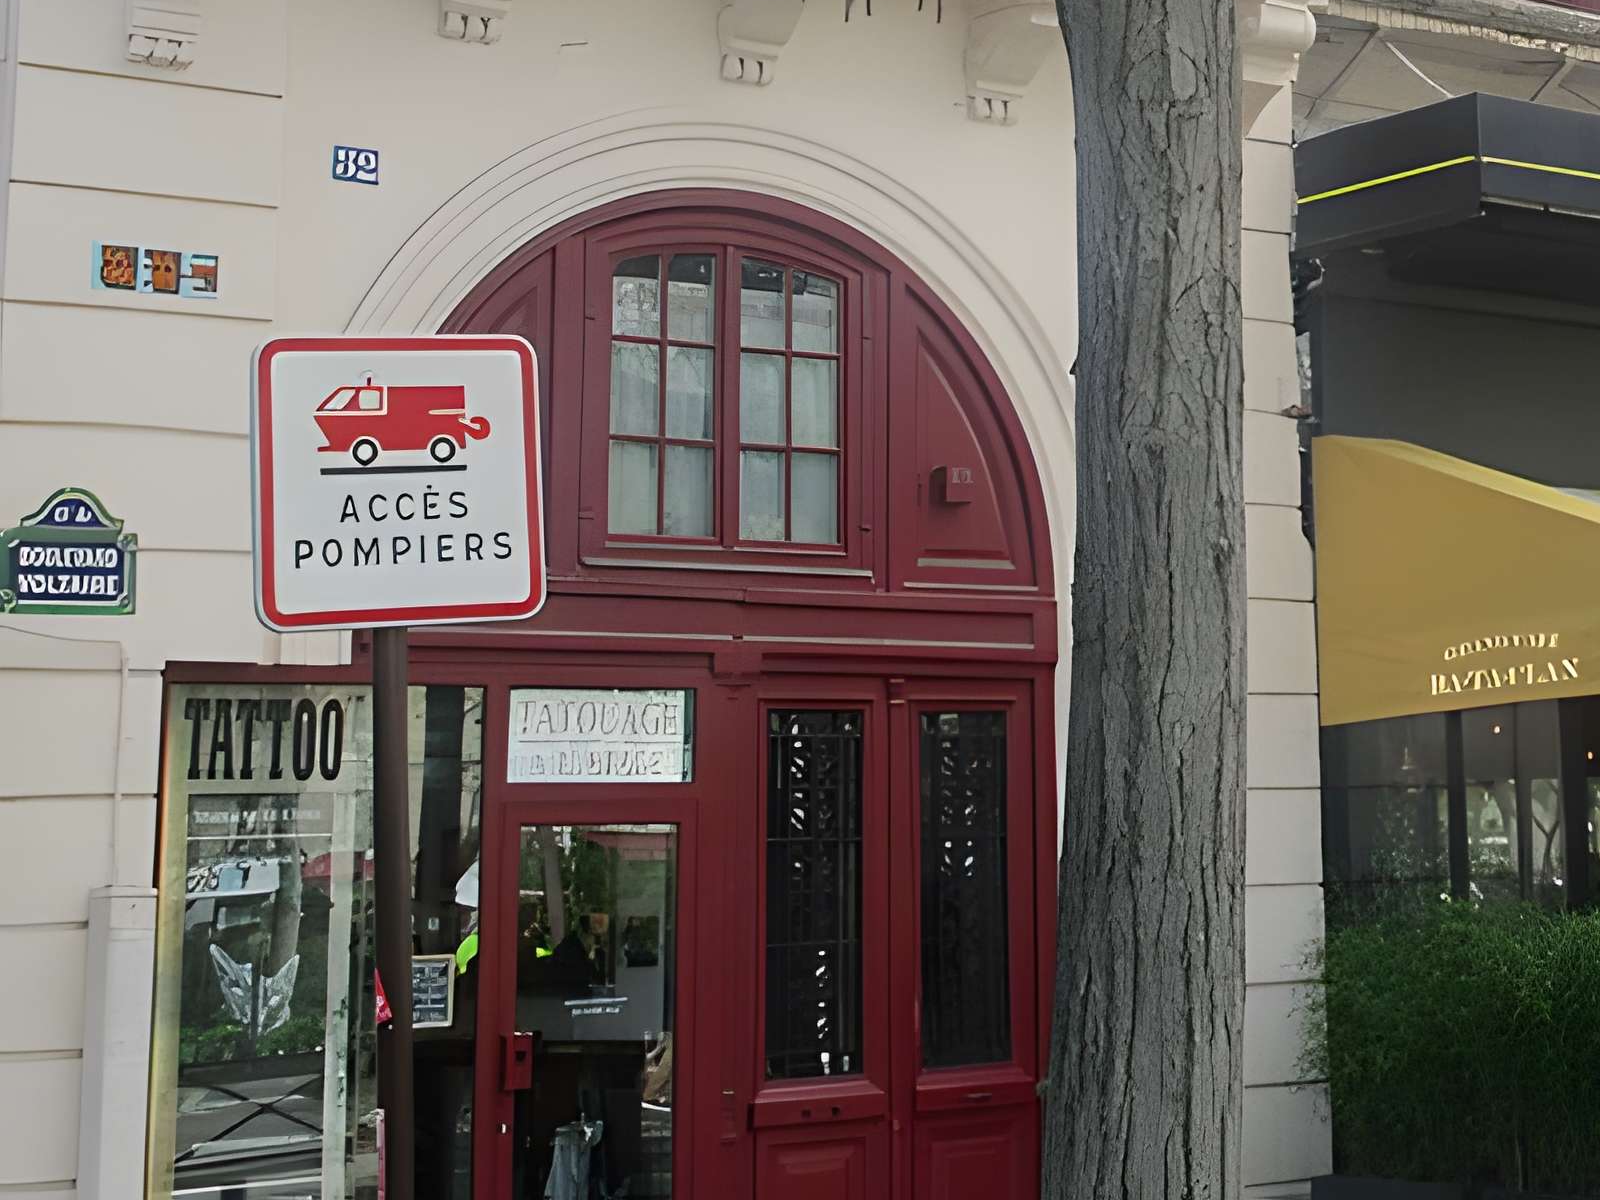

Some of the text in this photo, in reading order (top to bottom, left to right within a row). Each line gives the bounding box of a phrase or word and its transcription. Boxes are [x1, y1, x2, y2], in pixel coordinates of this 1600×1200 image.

[338, 484, 469, 524] ACCÈS
[18, 545, 119, 569] BOULEVARD
[293, 531, 514, 570] POMPIERS
[17, 573, 120, 596] VOLTAIRE
[516, 699, 679, 736] TATOUAGE
[183, 697, 345, 782] TATTOO
